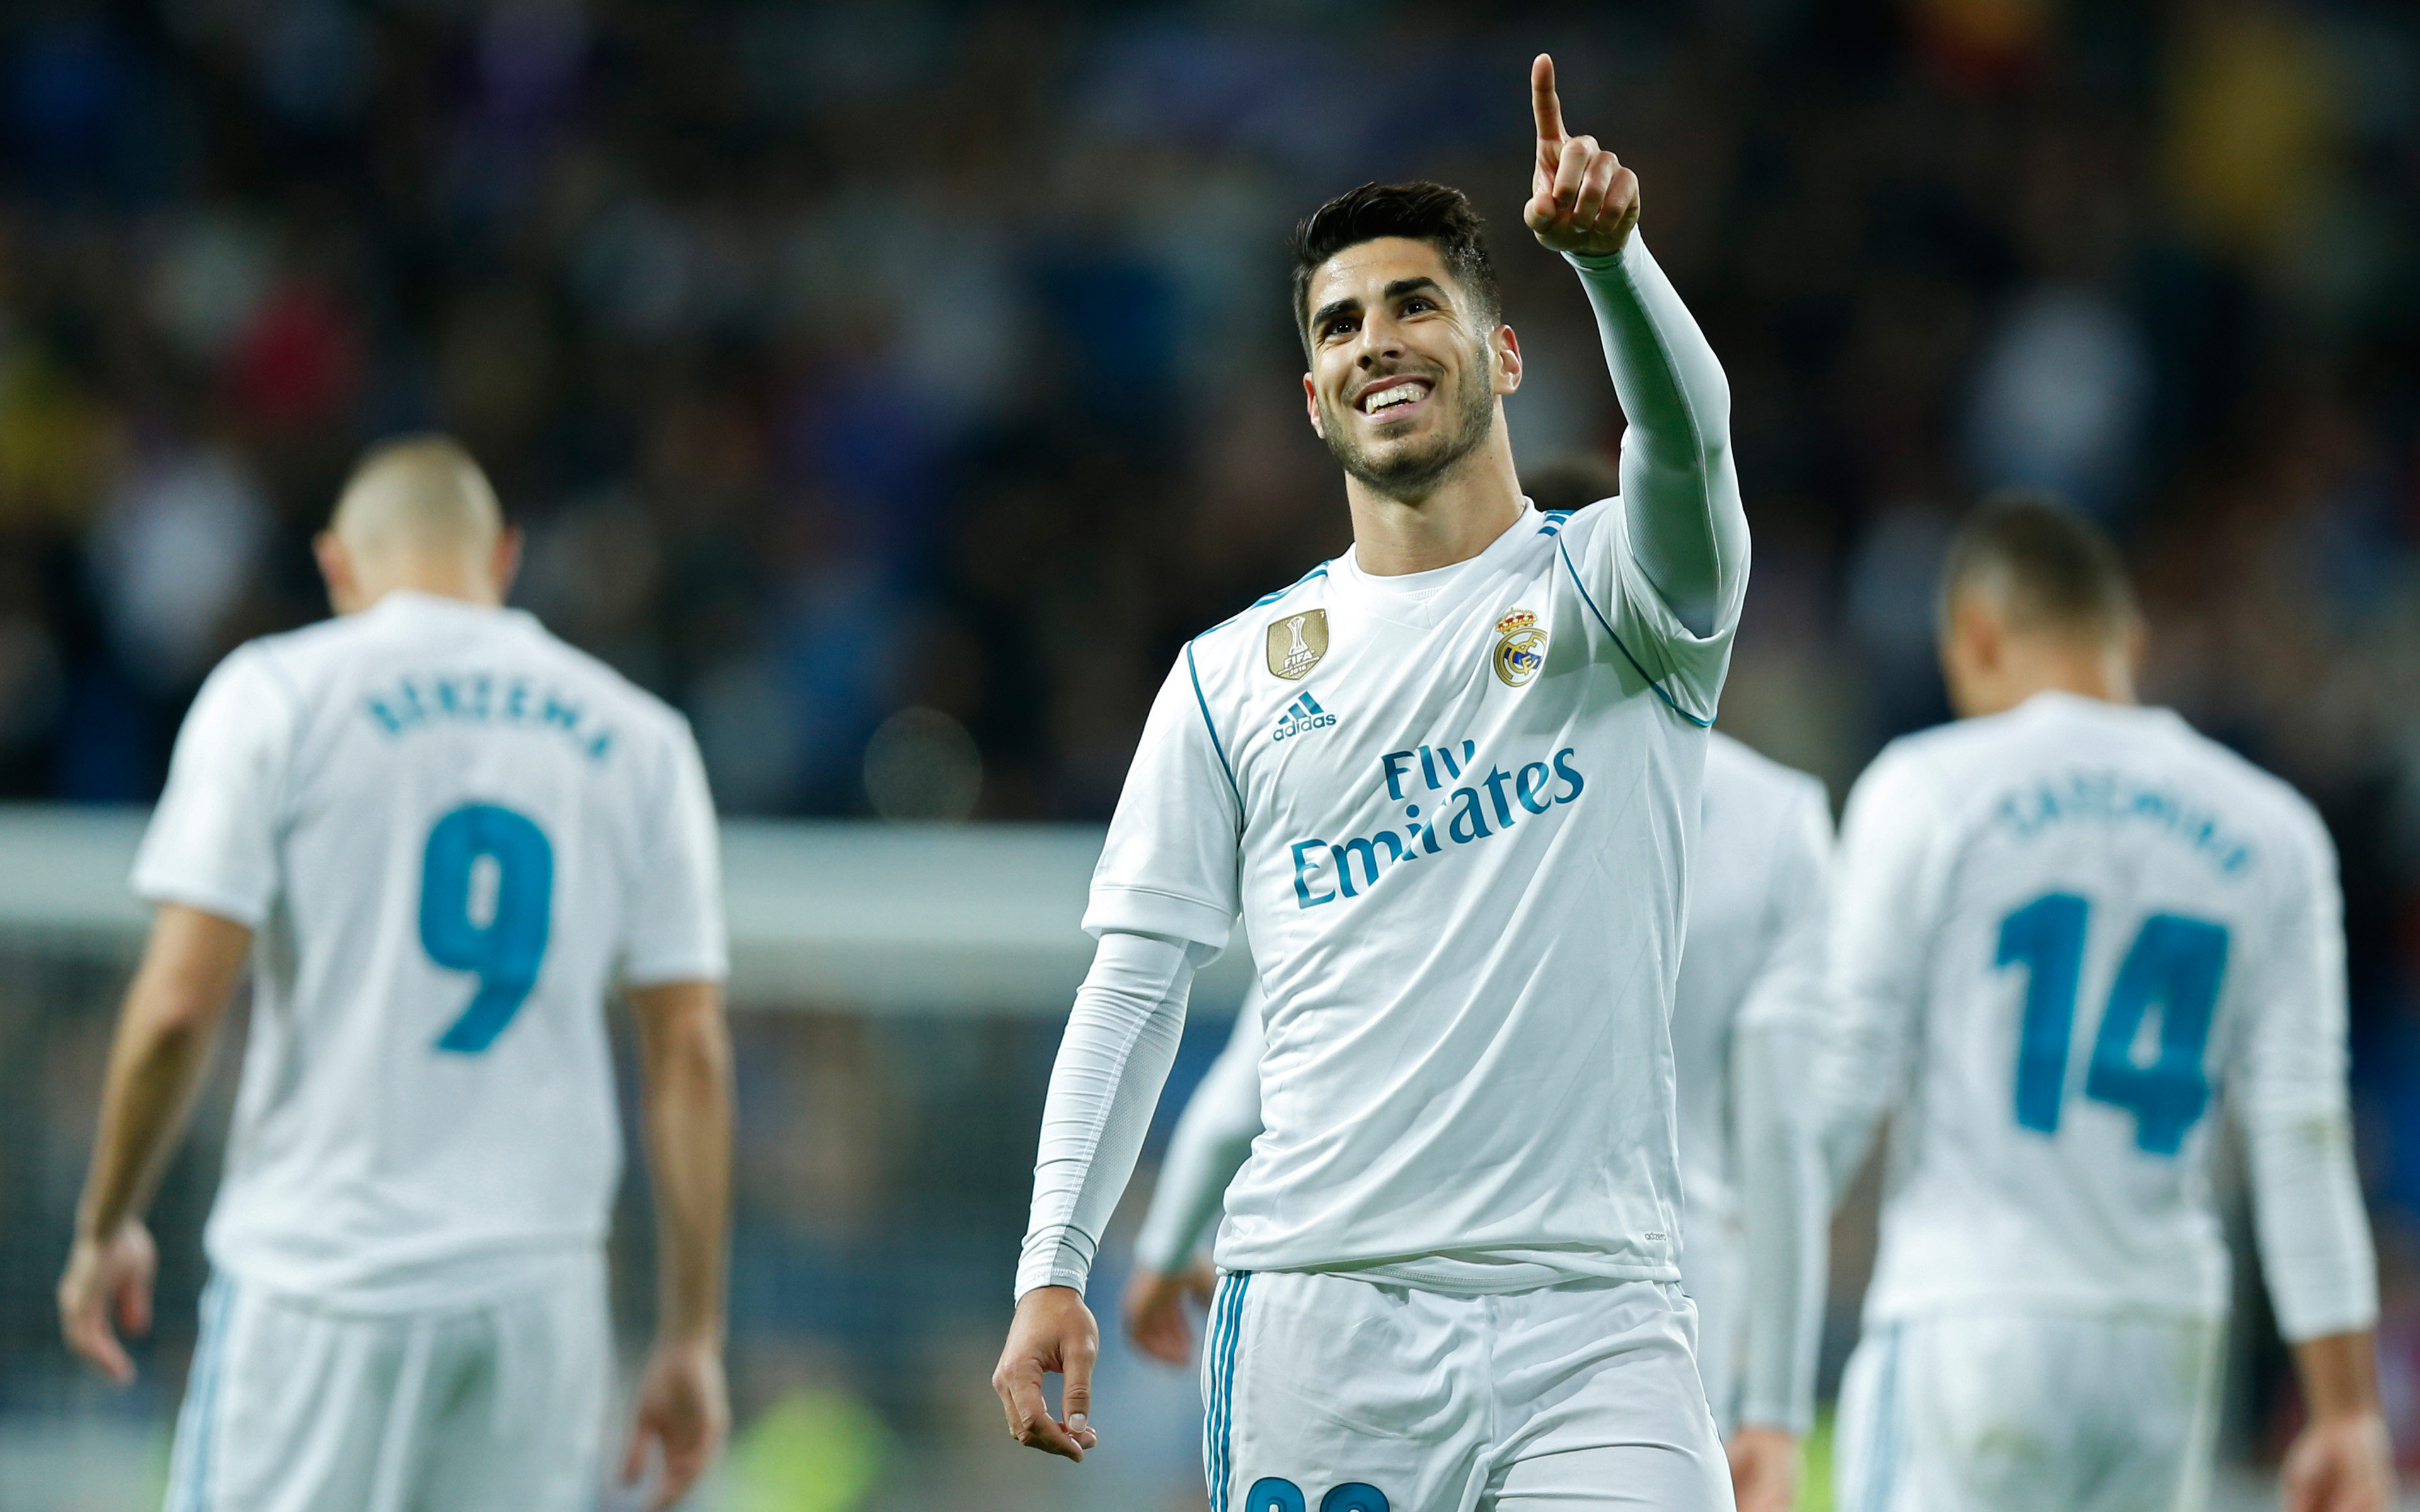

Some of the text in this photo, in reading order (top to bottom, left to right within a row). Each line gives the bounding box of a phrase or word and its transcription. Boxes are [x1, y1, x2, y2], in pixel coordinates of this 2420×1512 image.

[1284, 651, 1313, 668] FIFA
[1289, 665, 1307, 676] 2016
[1272, 711, 1337, 742] adidas
[1382, 739, 1475, 801] Fly
[1290, 748, 1584, 910] Emirates
[420, 800, 553, 1054] 9
[1995, 893, 2230, 1155] 14
